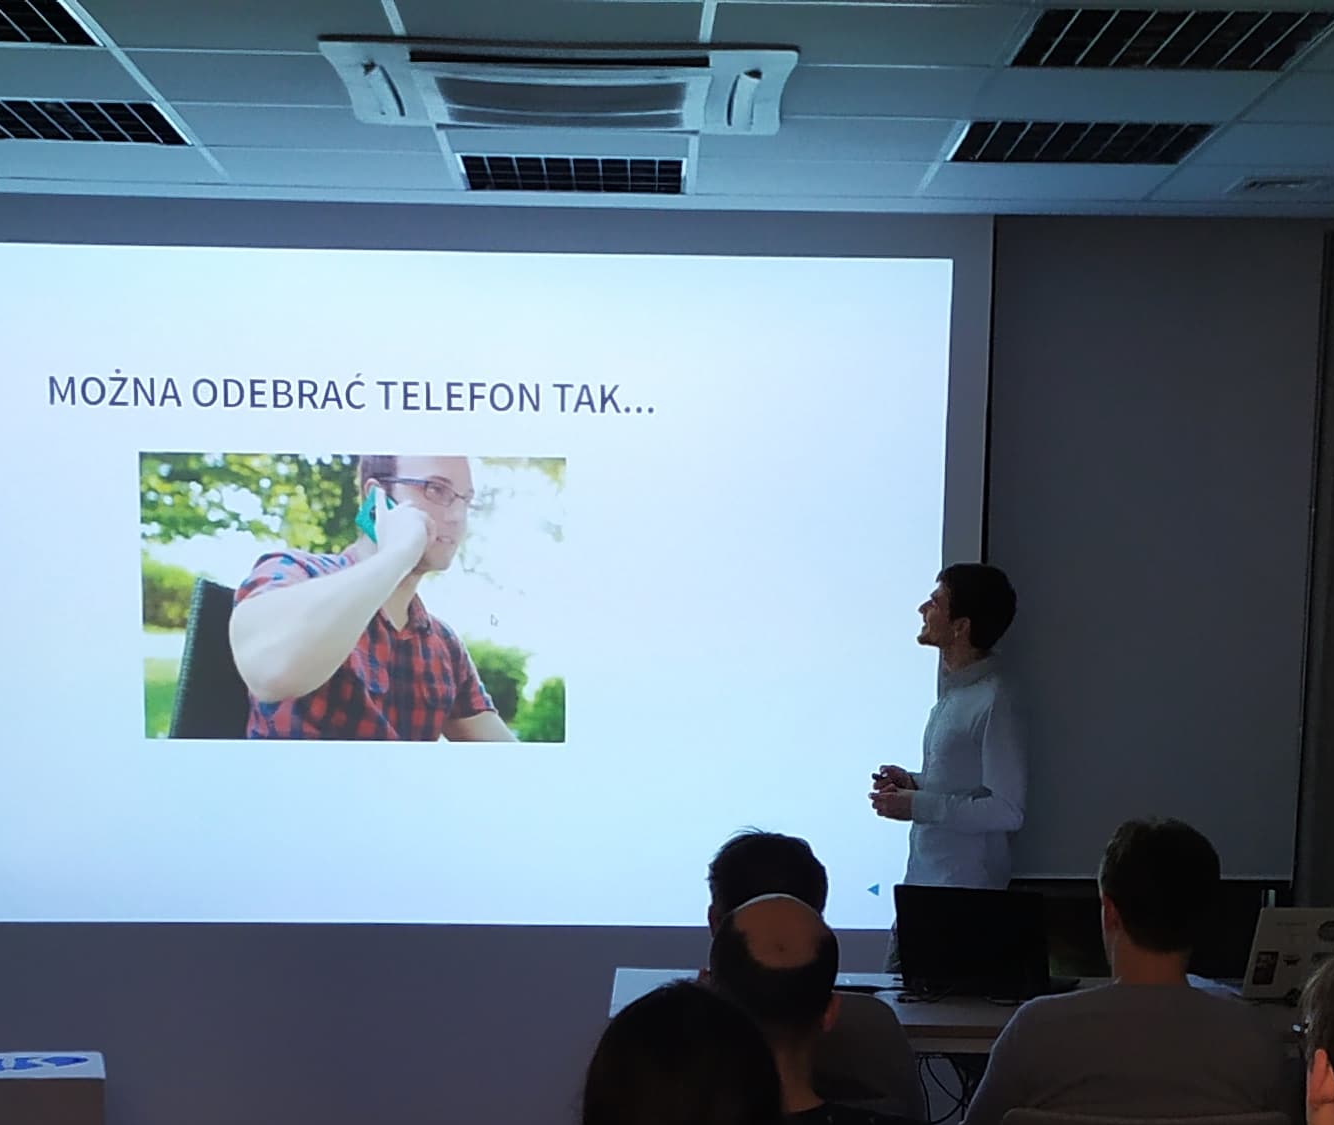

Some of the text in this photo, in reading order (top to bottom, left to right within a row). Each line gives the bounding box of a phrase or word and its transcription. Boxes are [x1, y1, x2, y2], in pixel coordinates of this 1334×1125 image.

[47, 368, 655, 415] MOŻNA ODEBRAĆ TELEFON TAK...
